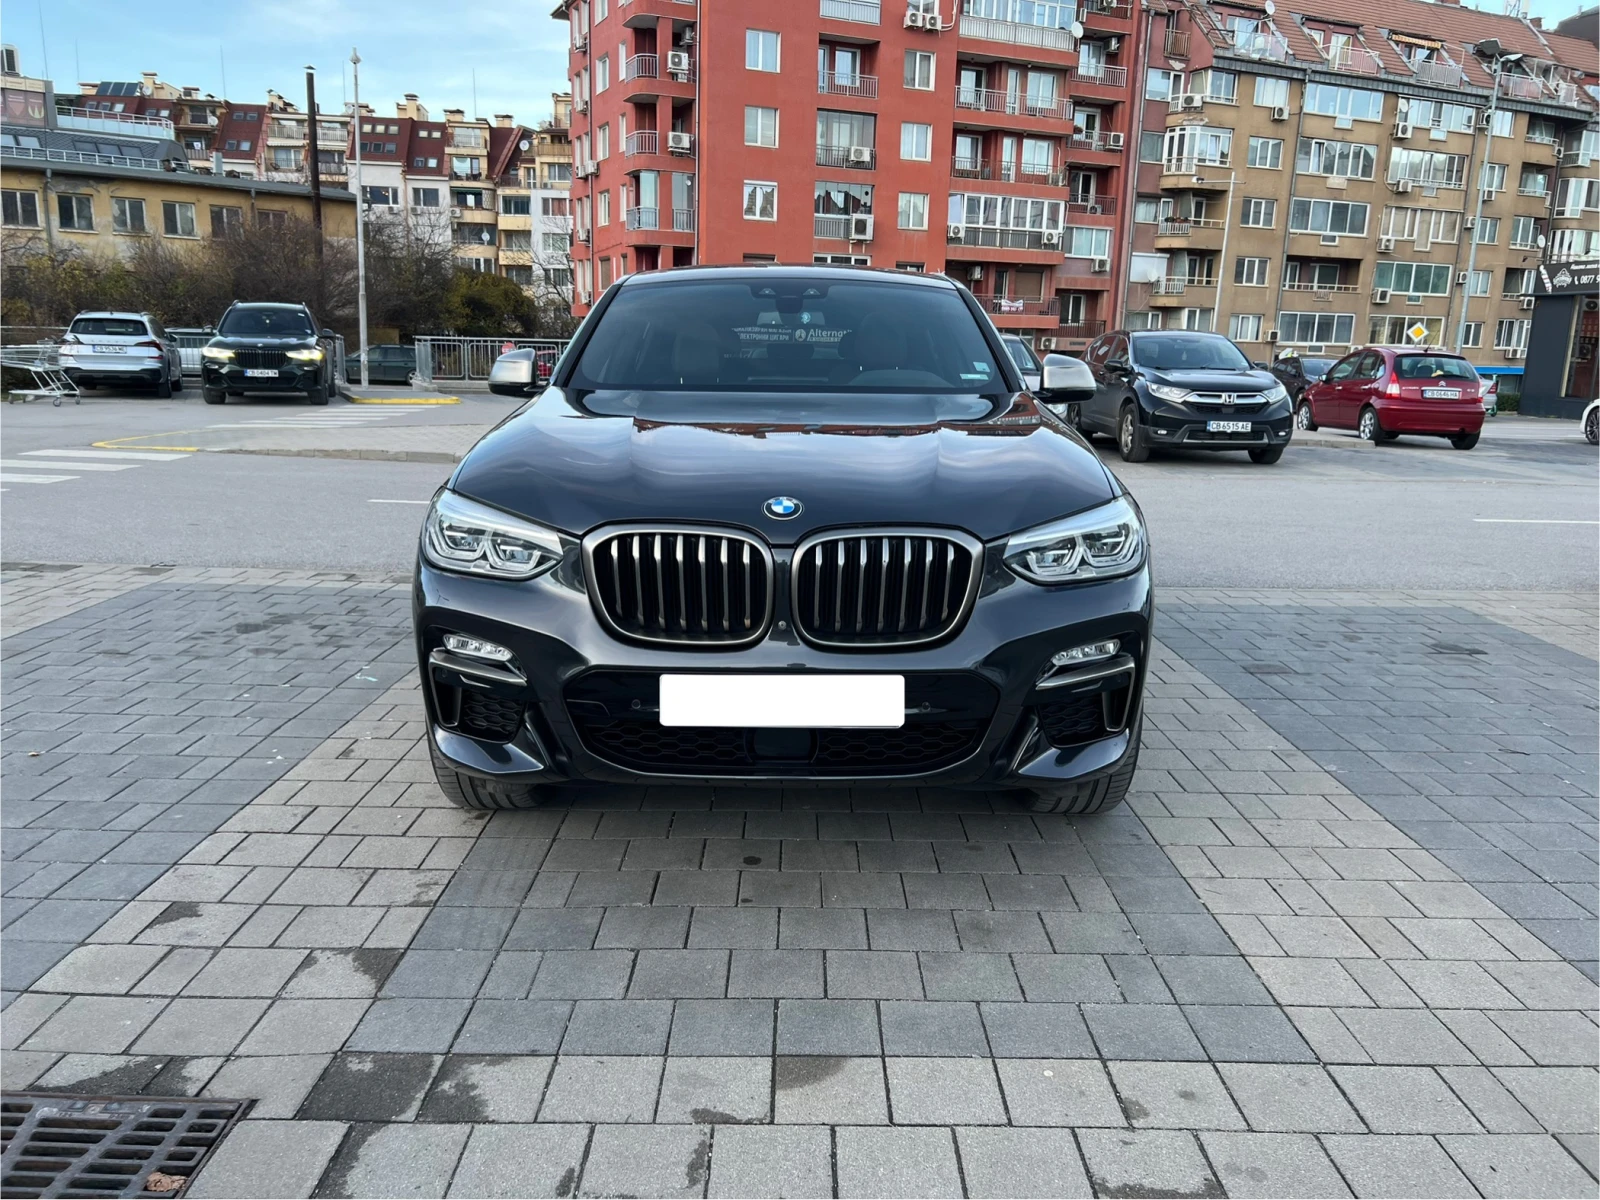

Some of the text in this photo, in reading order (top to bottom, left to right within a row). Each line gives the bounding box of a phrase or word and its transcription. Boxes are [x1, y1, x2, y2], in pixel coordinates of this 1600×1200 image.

[1211, 422, 1250, 431] CB 6515 AE
